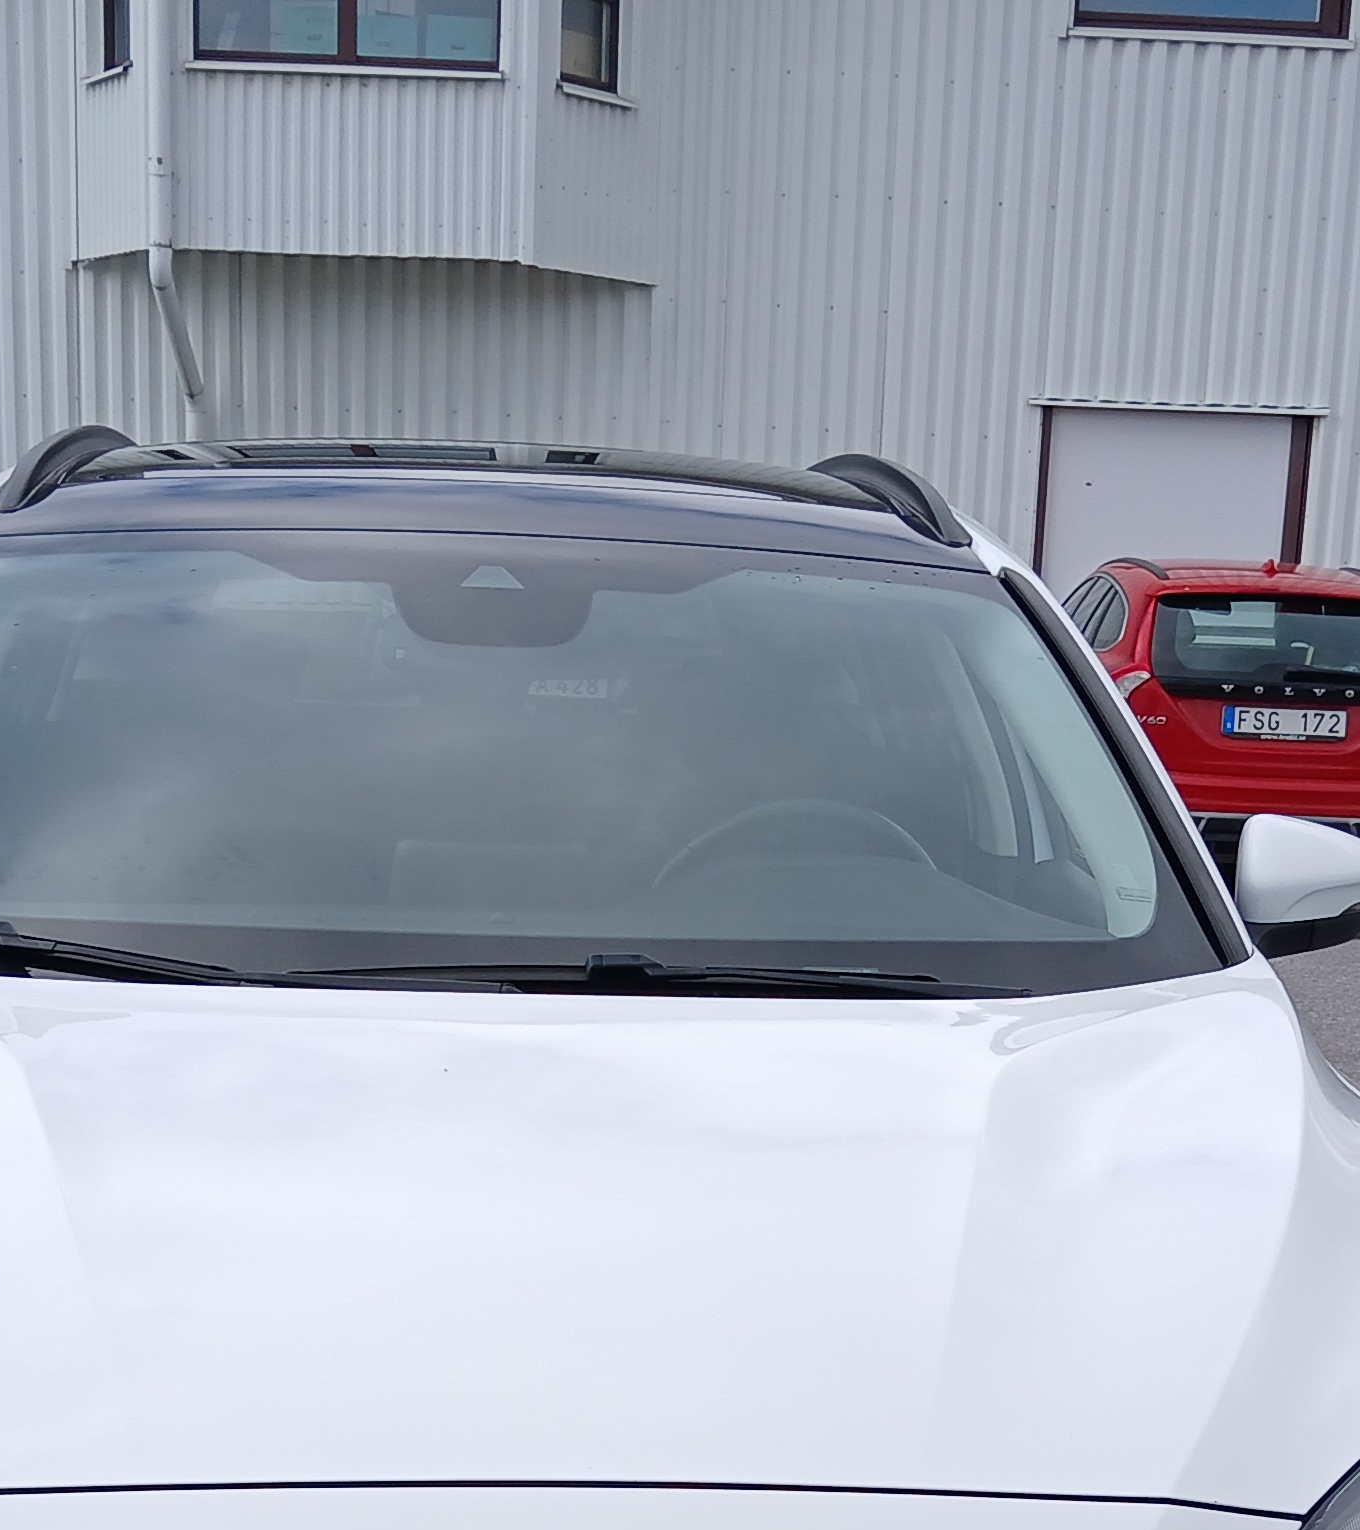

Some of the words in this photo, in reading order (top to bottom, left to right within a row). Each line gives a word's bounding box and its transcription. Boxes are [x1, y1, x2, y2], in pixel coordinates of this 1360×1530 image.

[1221, 684, 1355, 699] VOLVO
[1137, 714, 1167, 725] V60
[1237, 710, 1280, 731] FSG
[1300, 712, 1341, 734] 172
